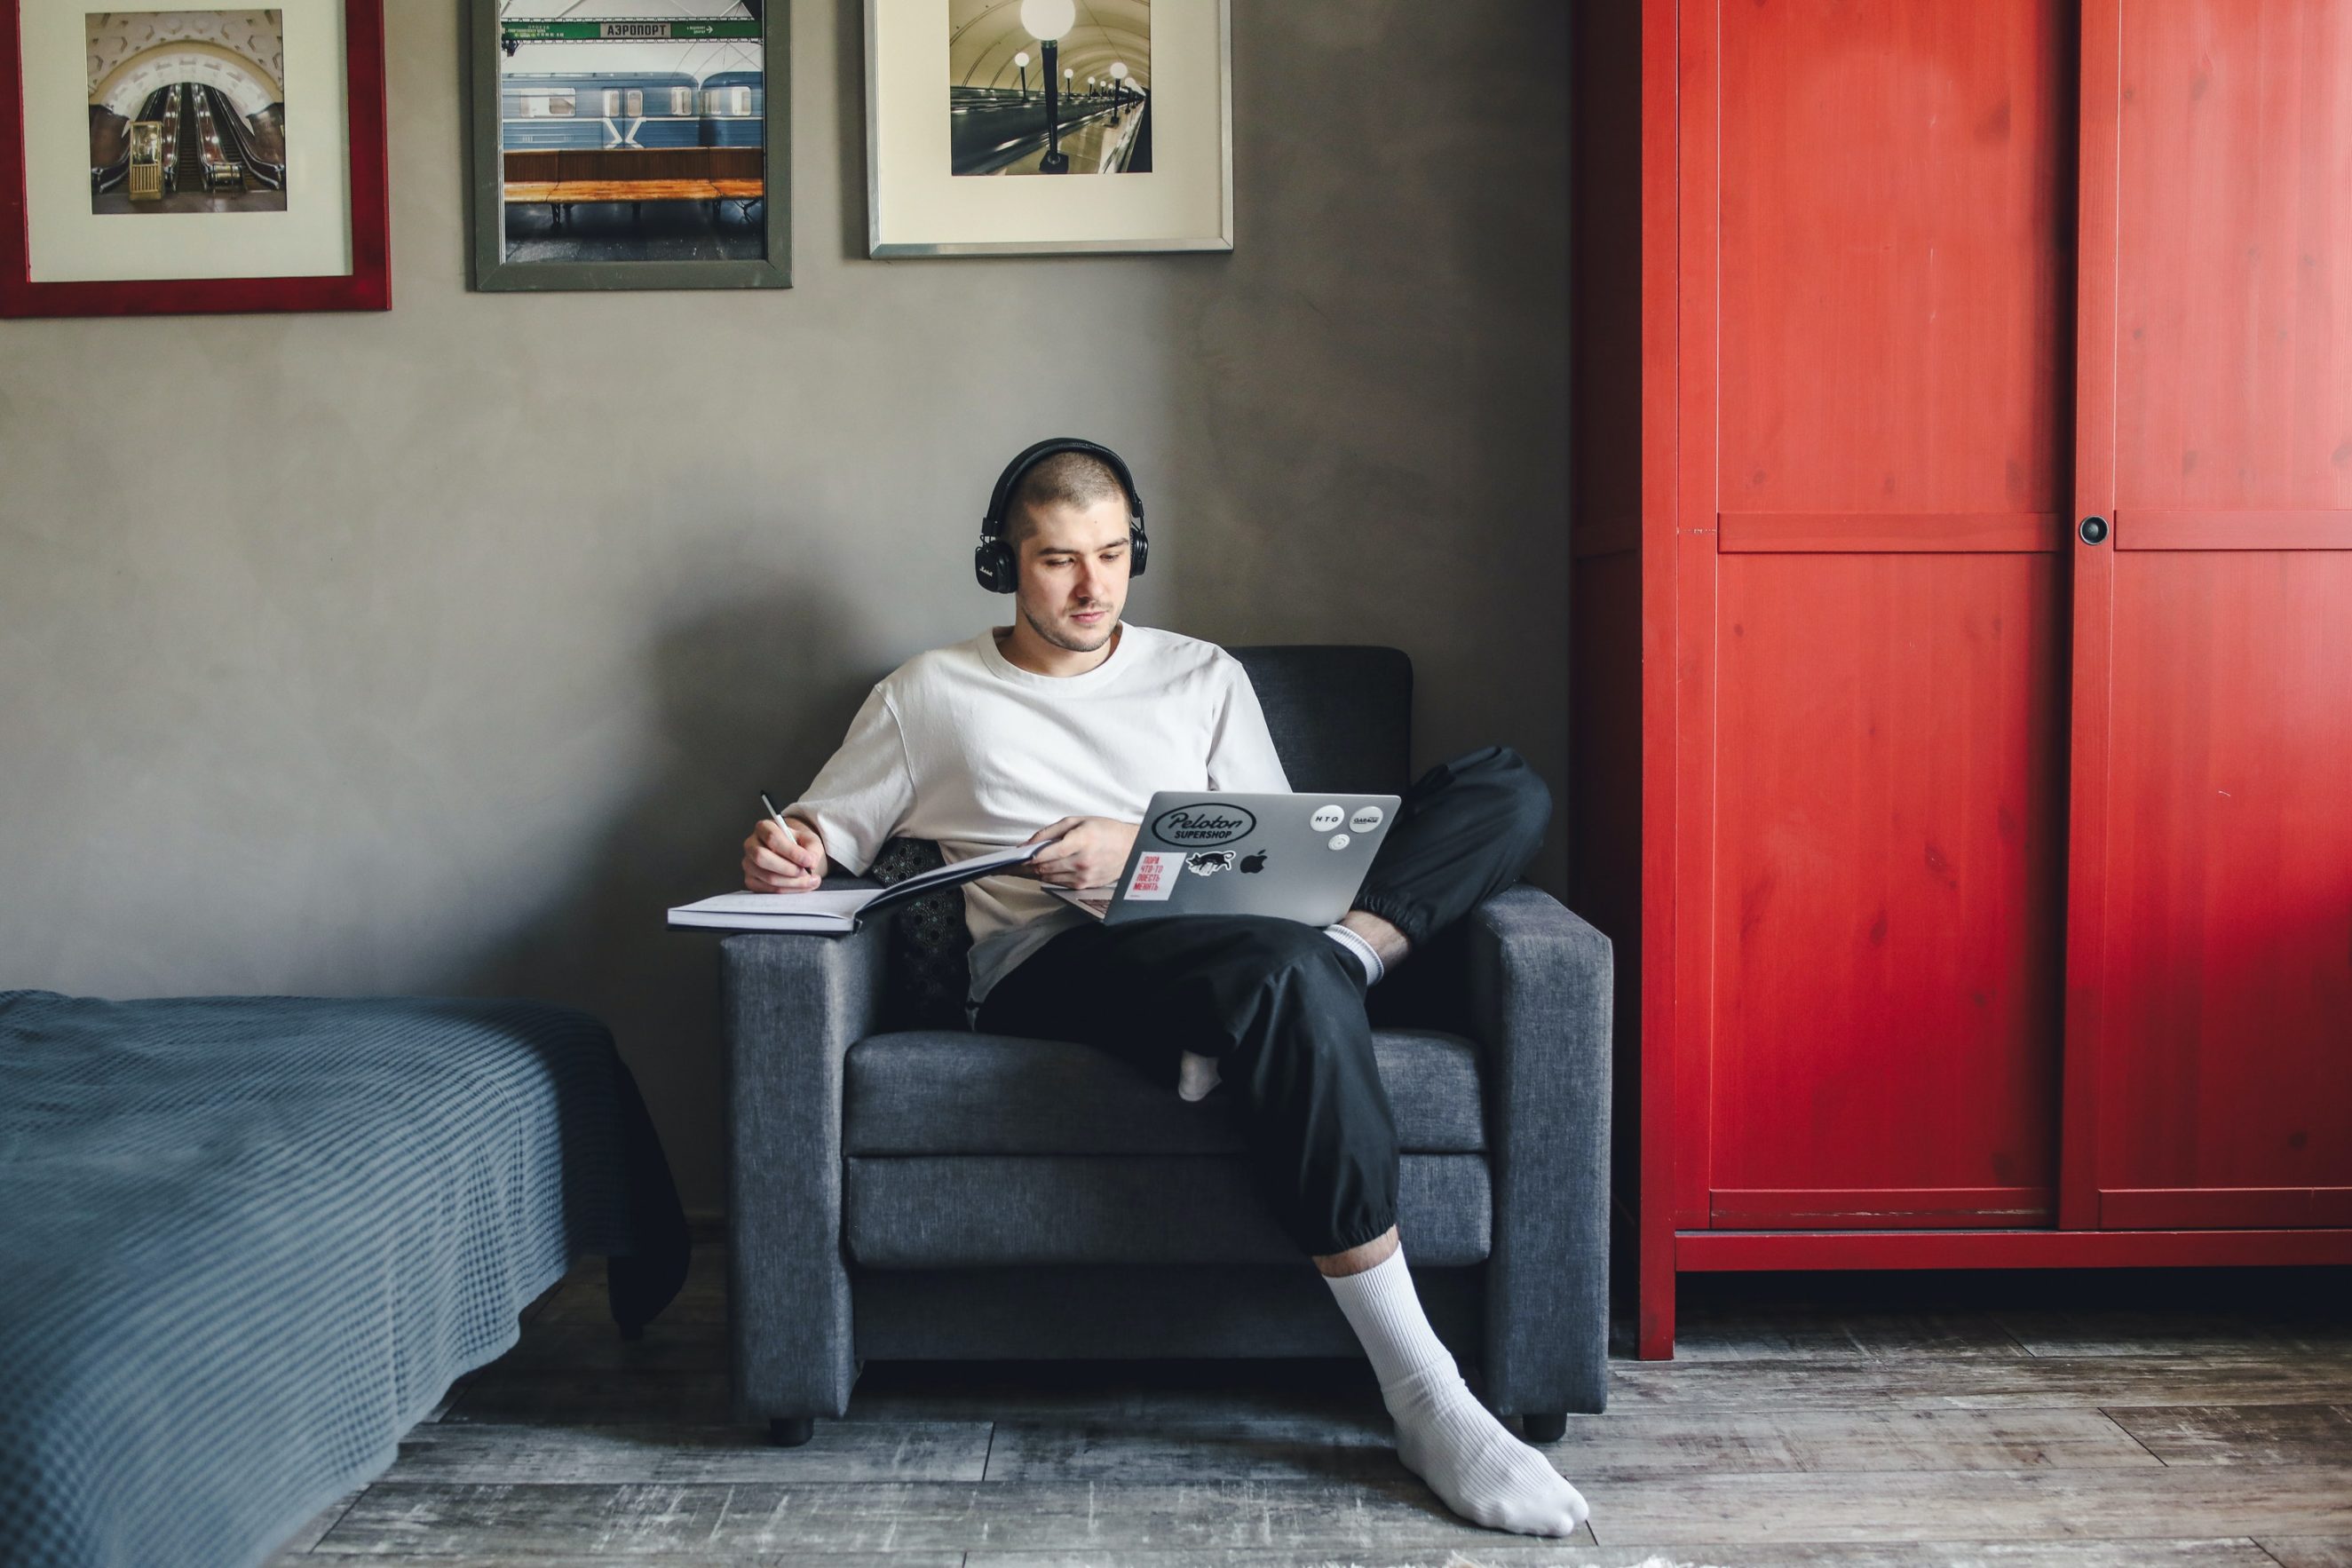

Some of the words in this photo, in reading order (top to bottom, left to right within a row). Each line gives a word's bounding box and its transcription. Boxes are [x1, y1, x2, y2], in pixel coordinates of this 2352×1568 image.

[607, 25, 666, 36] АЭРОПОРТ
[1168, 812, 1242, 829] Peloton
[1175, 830, 1232, 839] SUPERSHOP
